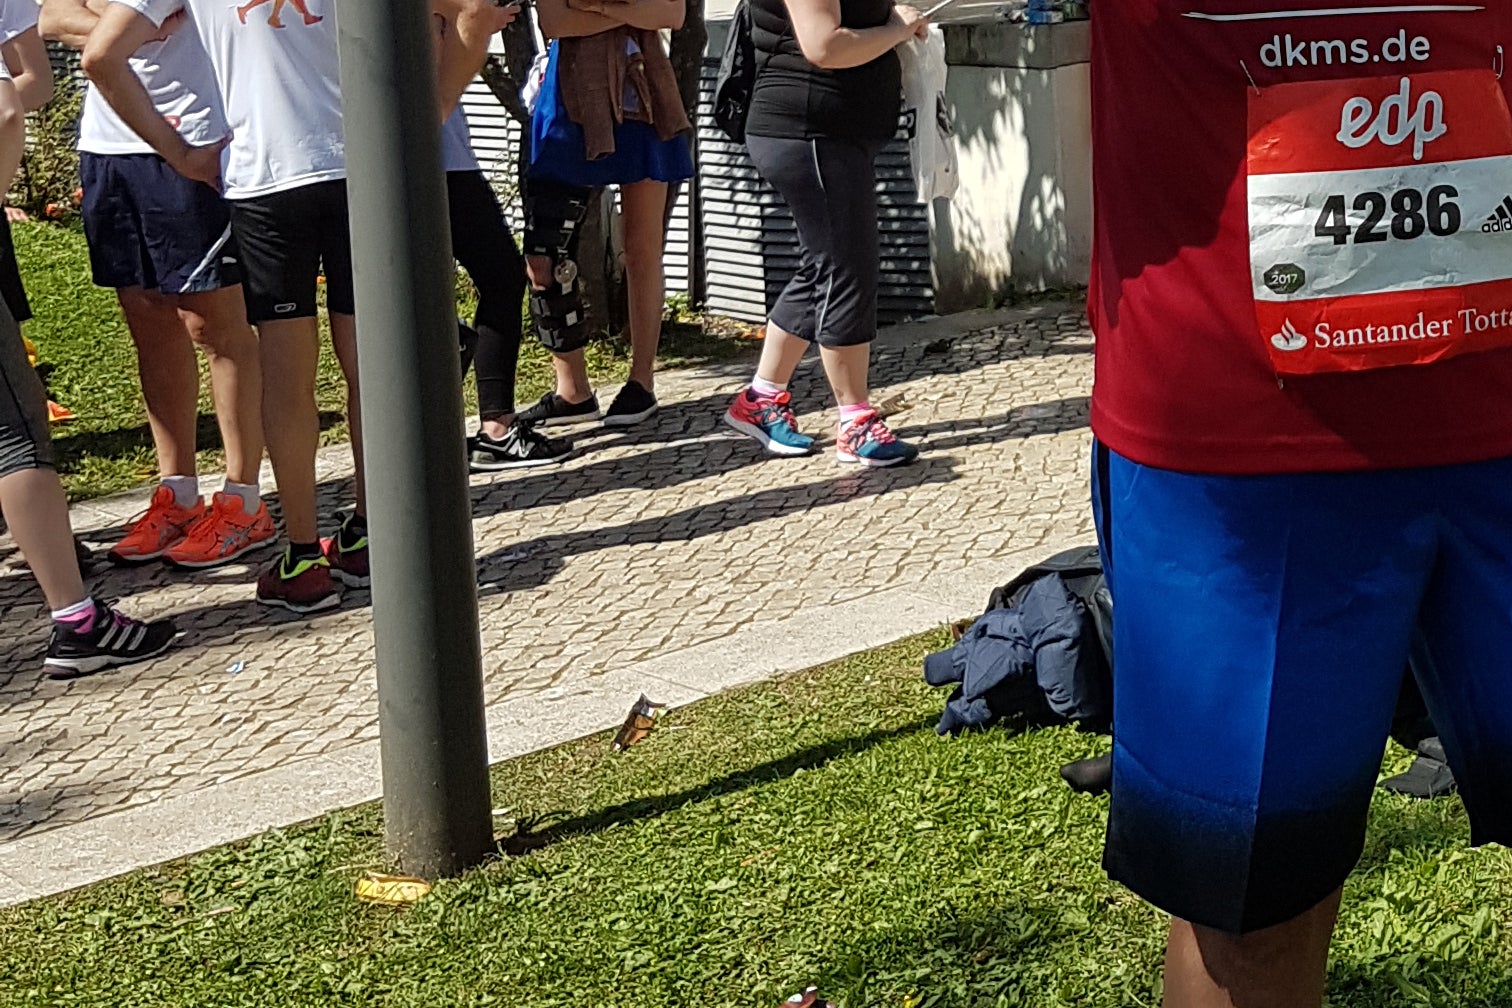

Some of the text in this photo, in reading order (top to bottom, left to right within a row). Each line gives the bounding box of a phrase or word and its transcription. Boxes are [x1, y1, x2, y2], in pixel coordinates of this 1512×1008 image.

[1259, 29, 1430, 68] dkms.de
[1336, 77, 1447, 161] edp
[1314, 185, 1462, 246] 4286
[1270, 273, 1298, 285] 2017
[1315, 311, 1452, 349] Santander
